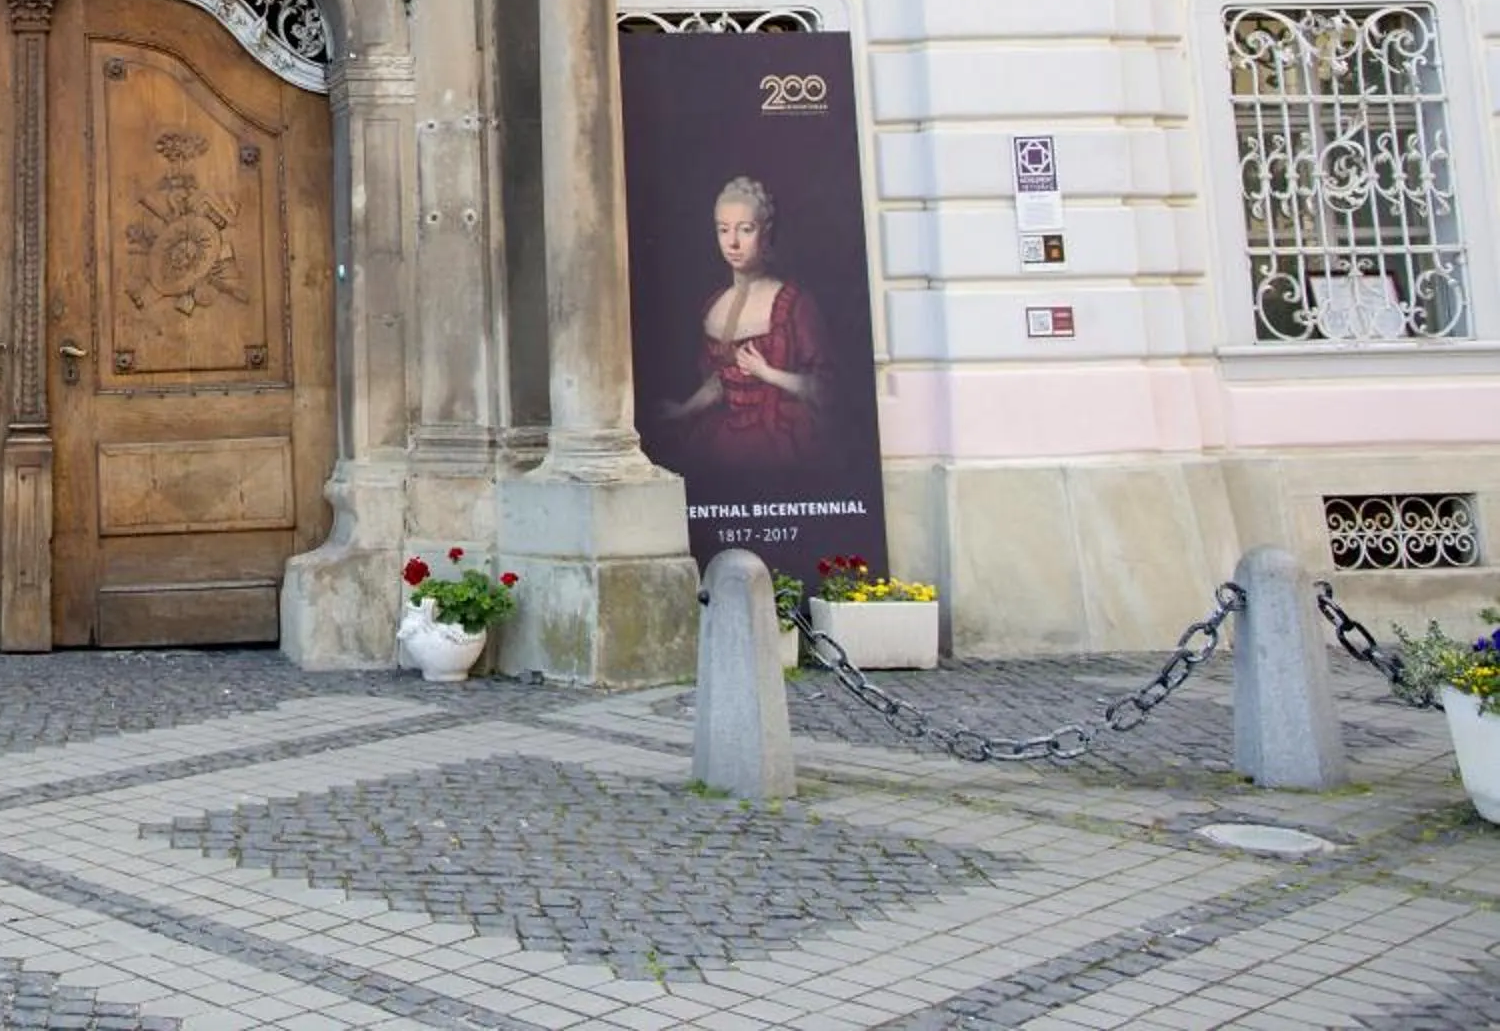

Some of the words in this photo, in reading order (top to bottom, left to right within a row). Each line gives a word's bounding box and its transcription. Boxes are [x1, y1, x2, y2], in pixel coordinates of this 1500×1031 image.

[759, 74, 827, 110] 200
[685, 504, 750, 518] ENTHAL
[753, 500, 866, 517] BICENTENNIAL
